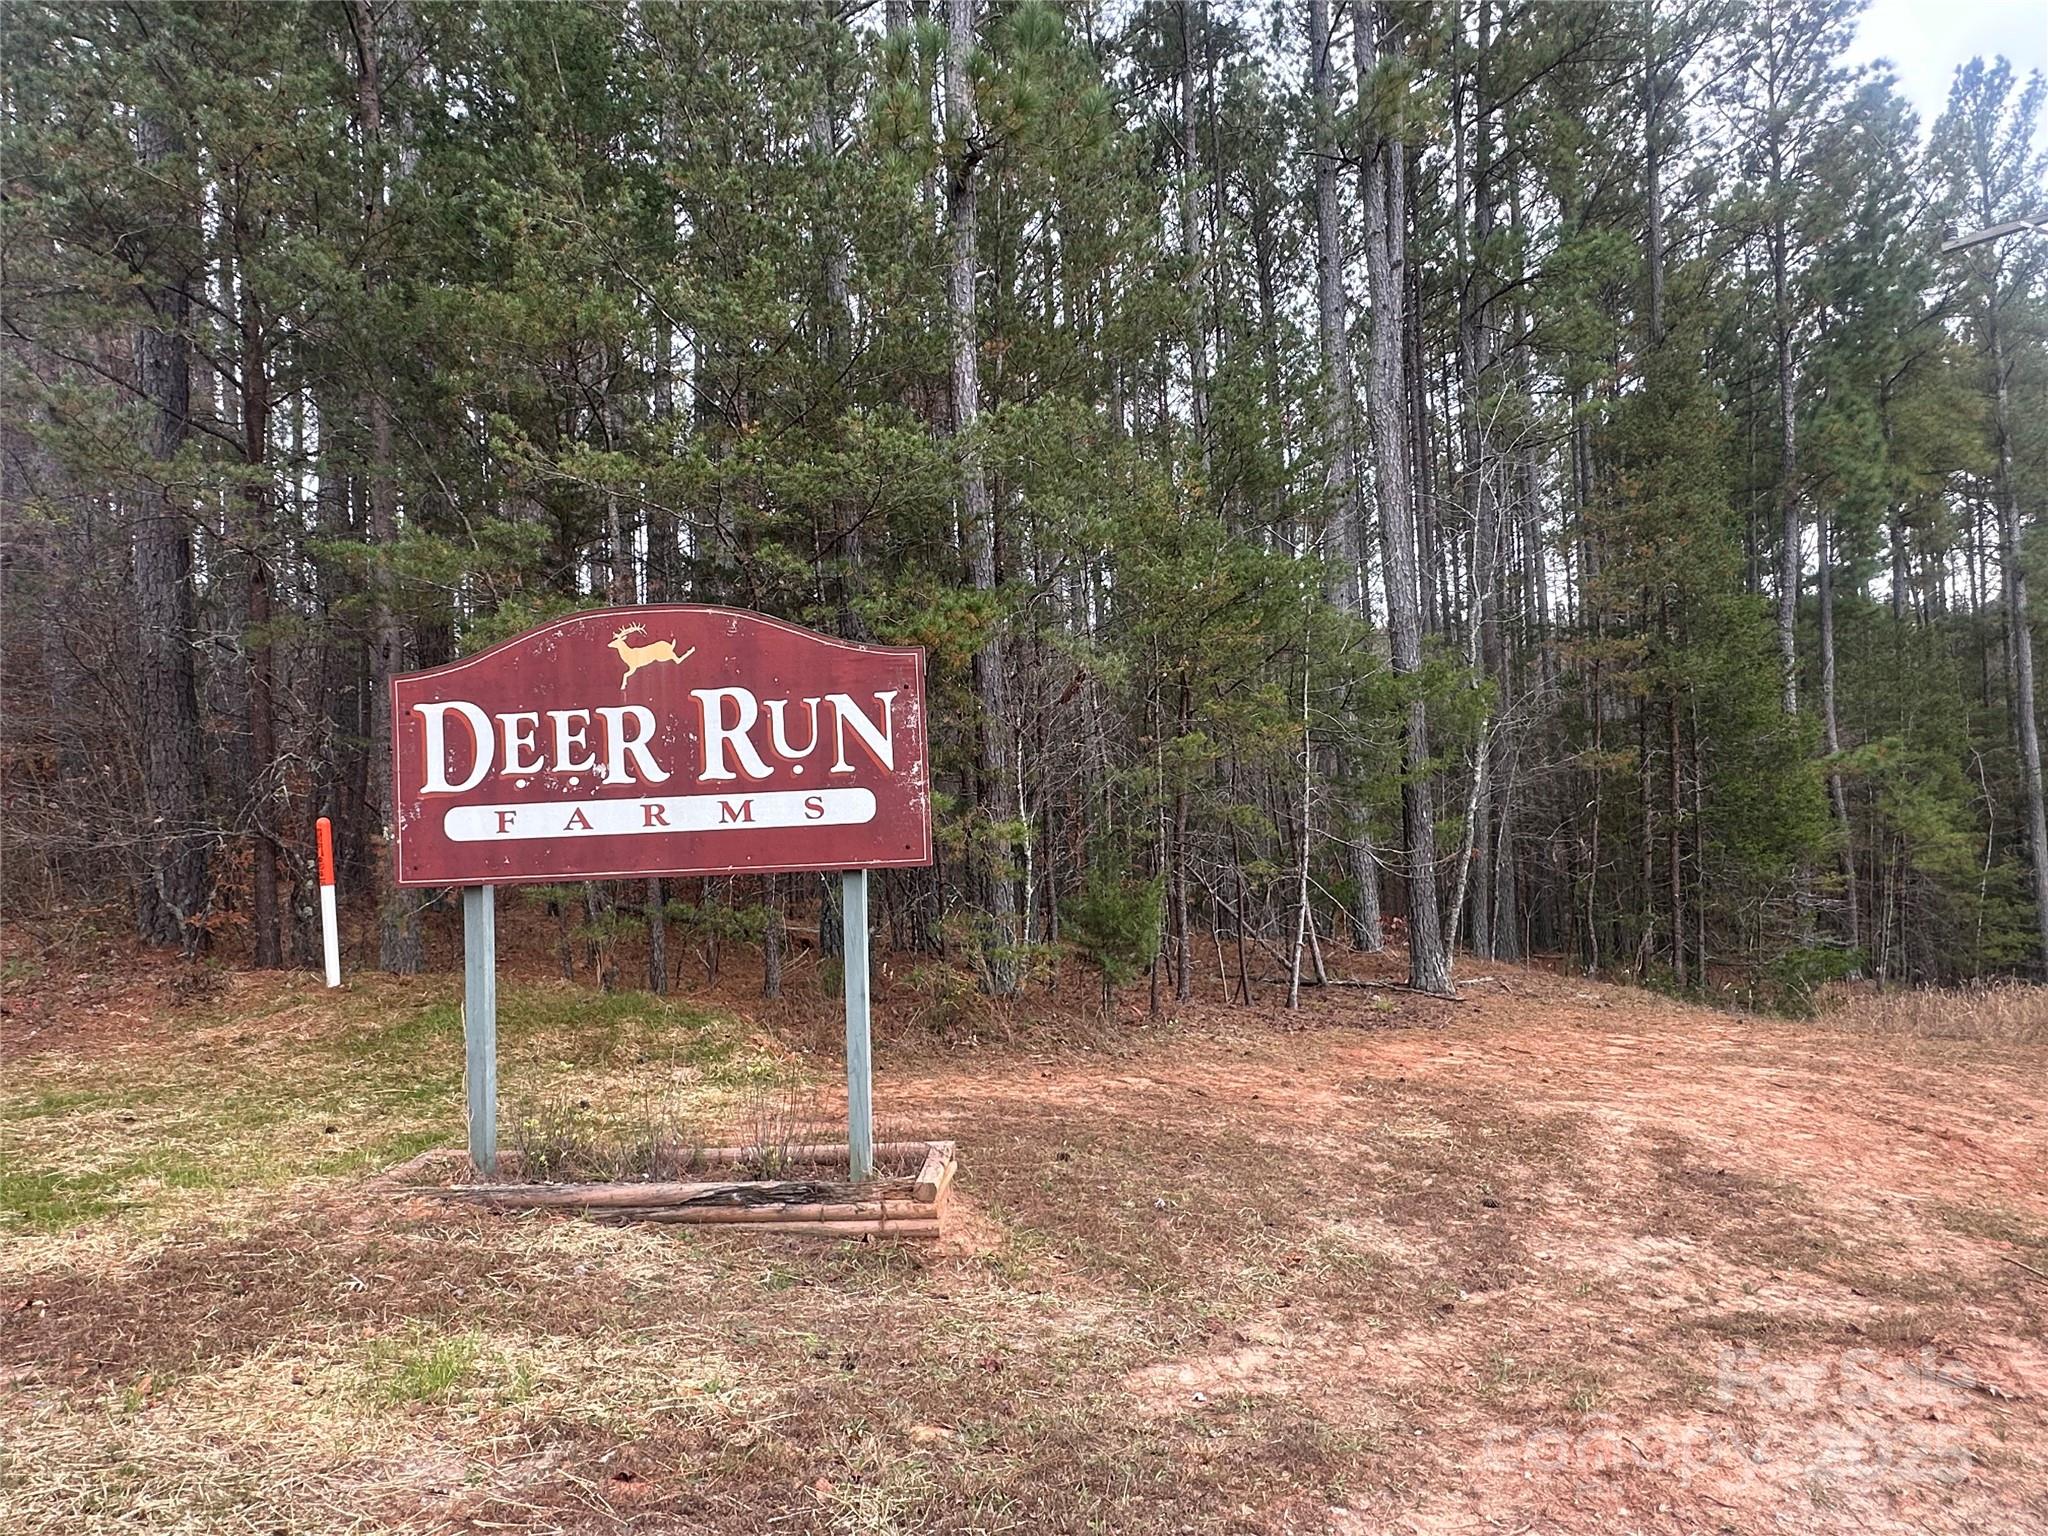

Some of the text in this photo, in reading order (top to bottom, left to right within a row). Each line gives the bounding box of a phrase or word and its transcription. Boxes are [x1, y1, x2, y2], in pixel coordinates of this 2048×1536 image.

[413, 686, 898, 796] DEER RUN
[494, 795, 825, 834] FARMS
